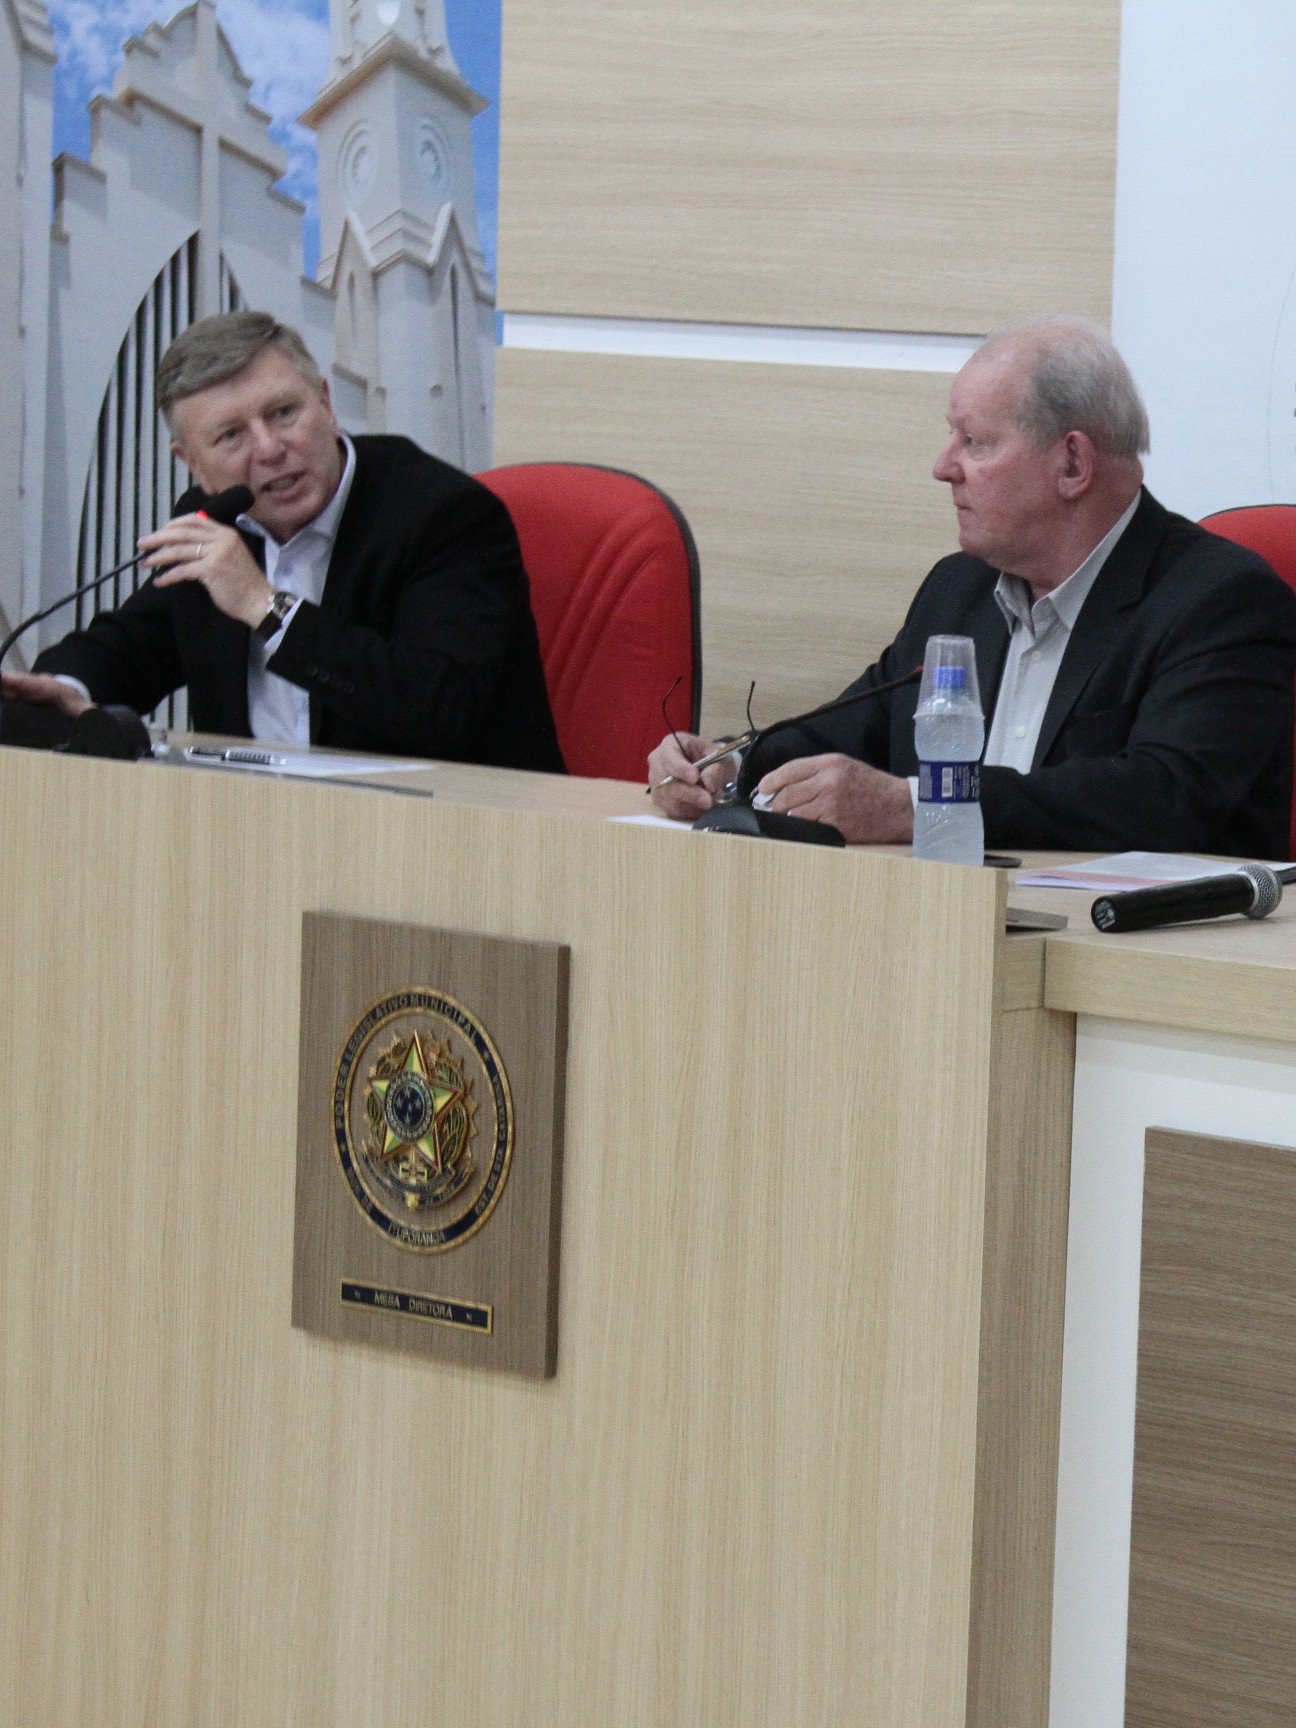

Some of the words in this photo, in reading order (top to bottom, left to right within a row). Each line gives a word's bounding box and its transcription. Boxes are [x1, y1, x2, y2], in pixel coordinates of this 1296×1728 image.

[334, 1062, 351, 1129] PODER
[410, 993, 479, 1045] MUNICIPAL
[374, 1290, 401, 1310] MESA
[408, 1296, 453, 1320] DIRETORA
